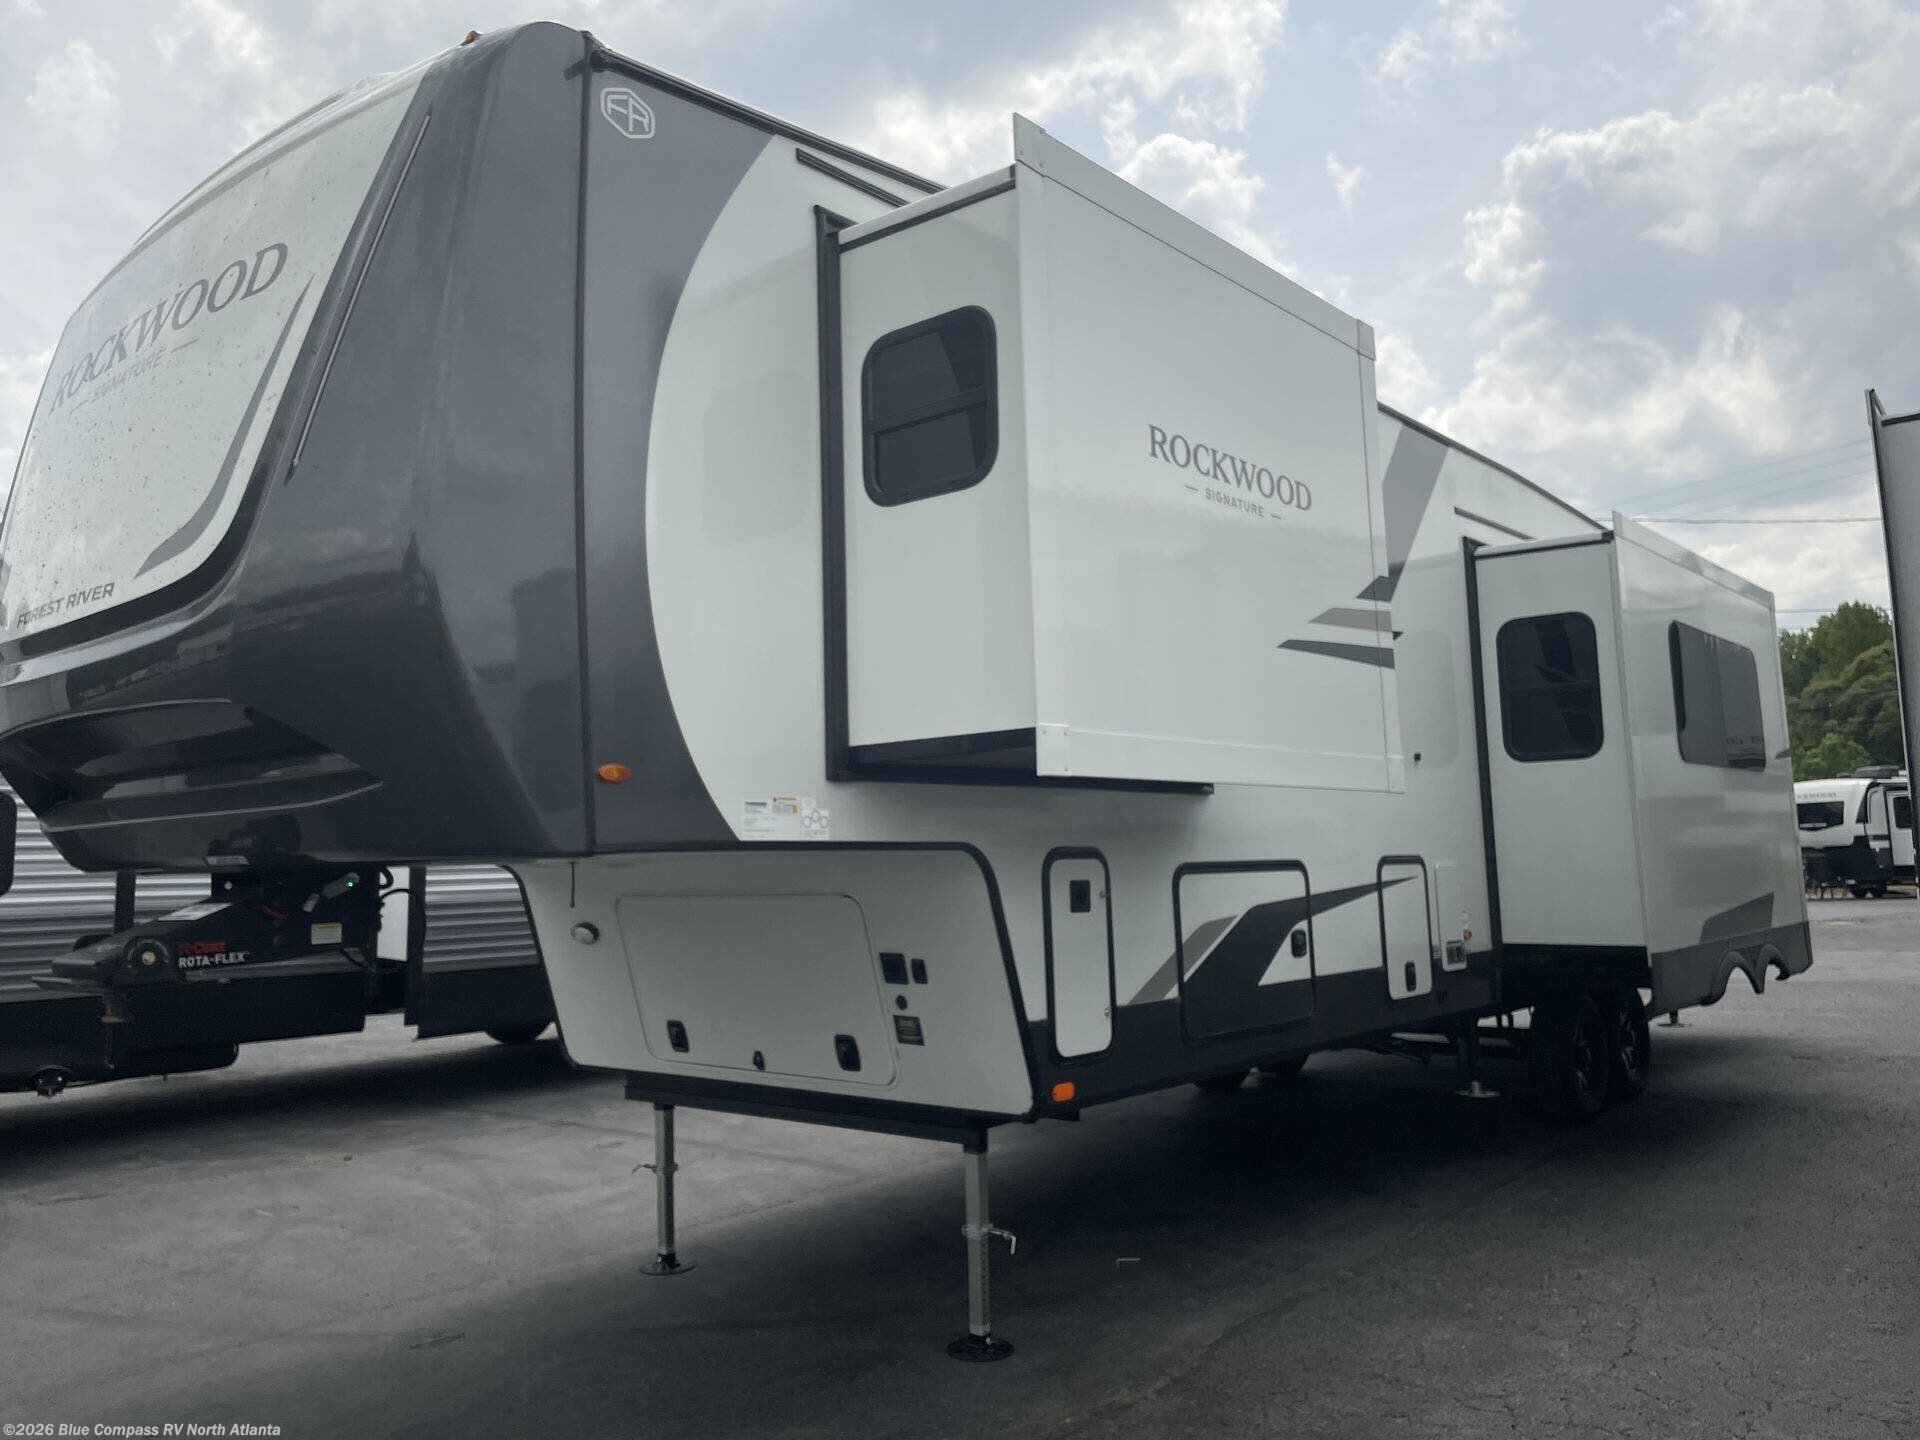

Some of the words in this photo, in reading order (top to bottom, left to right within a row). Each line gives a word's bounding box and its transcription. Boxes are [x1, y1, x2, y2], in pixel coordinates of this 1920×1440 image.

[48, 243, 288, 416] ROCKWOOD
[1148, 424, 1312, 511] ROCKWOOD
[1205, 488, 1264, 518] SIGNATURE
[16, 597, 64, 630] FOREST
[66, 582, 115, 611] RIVER
